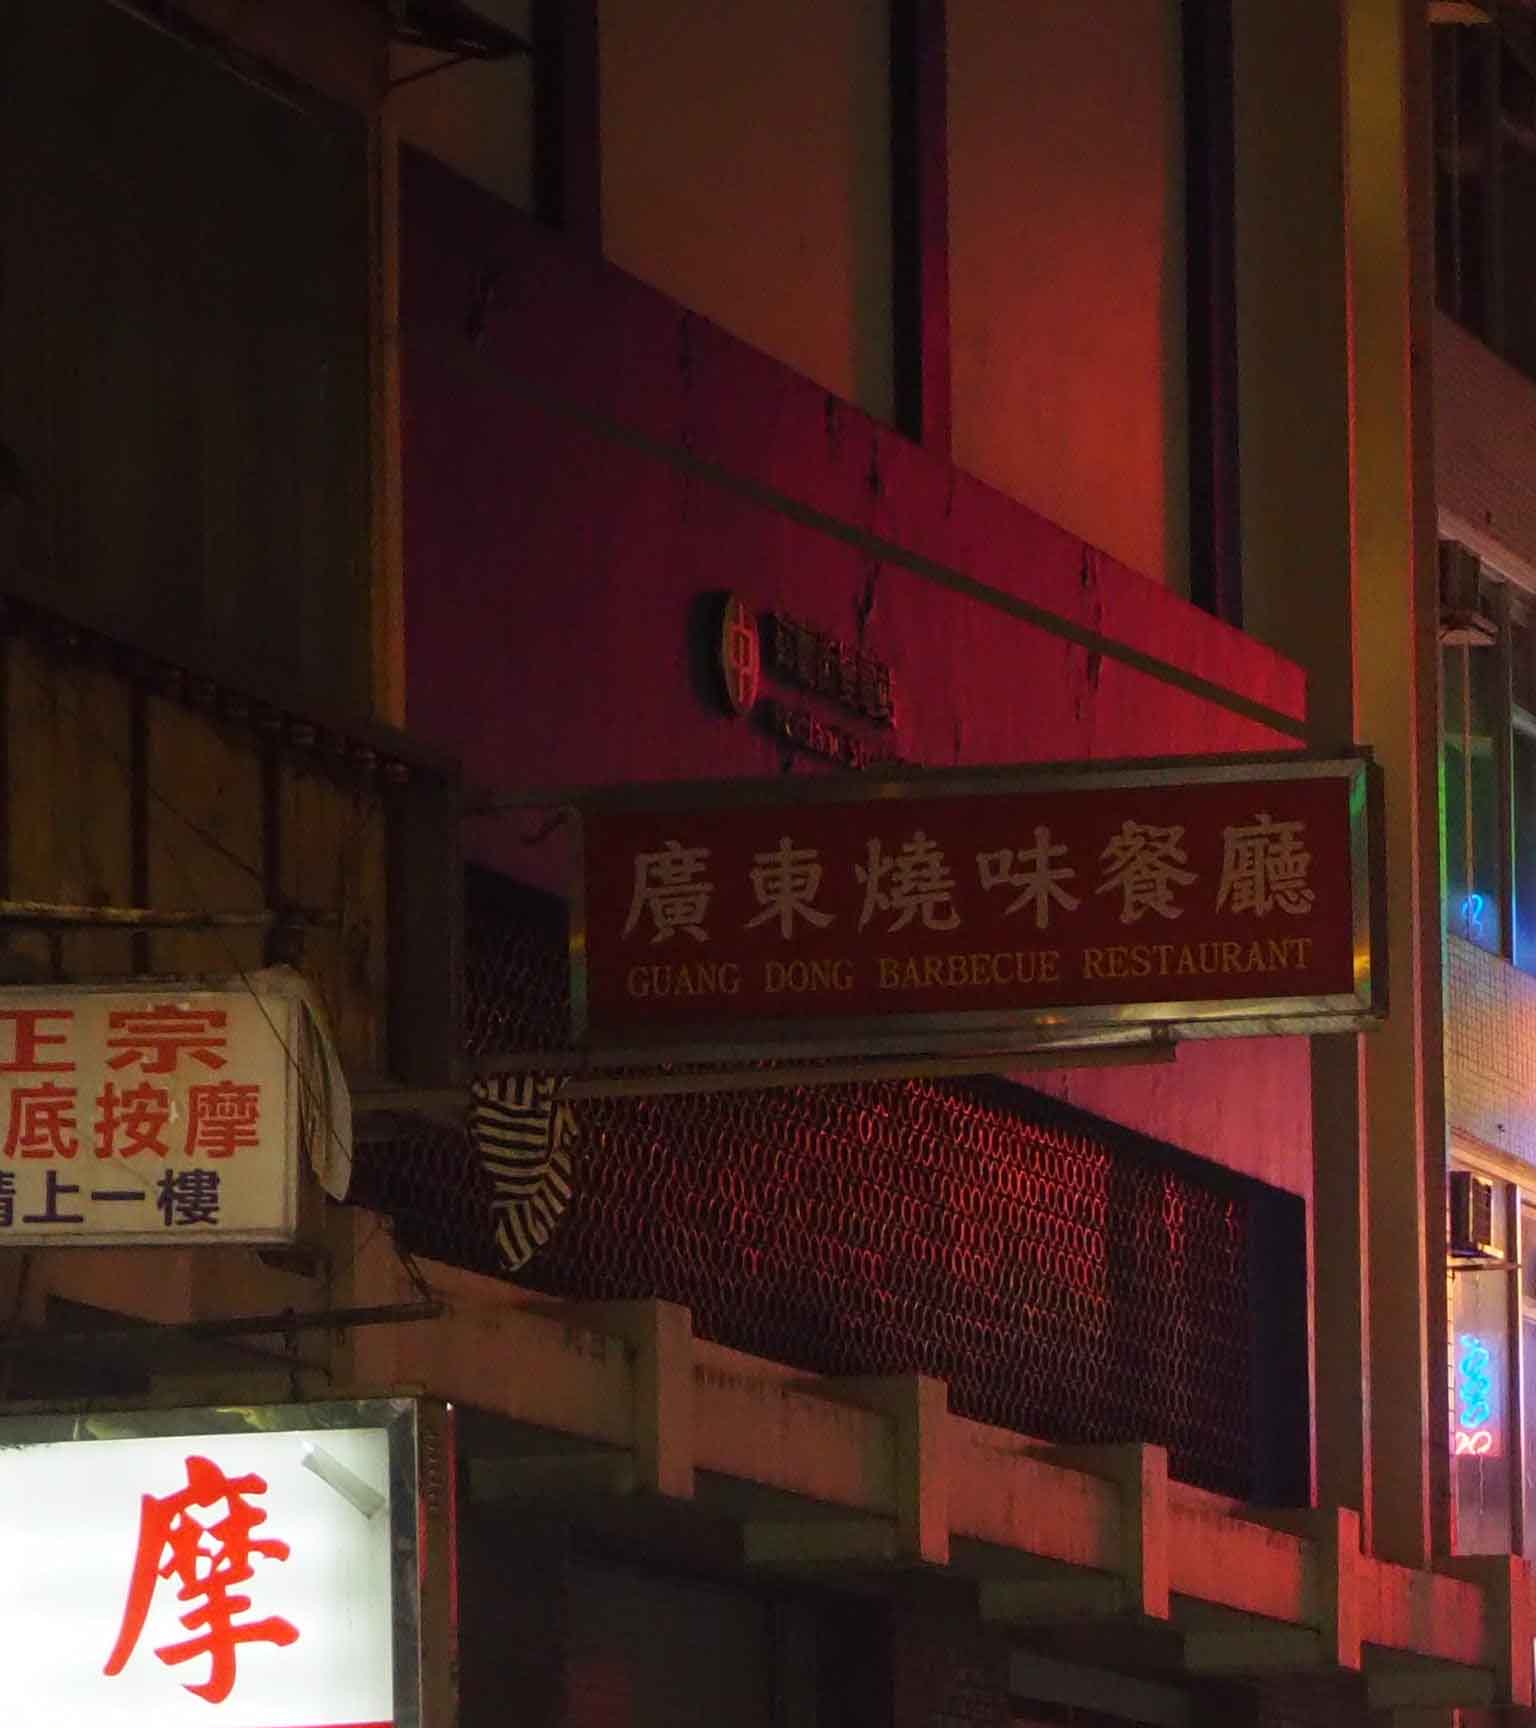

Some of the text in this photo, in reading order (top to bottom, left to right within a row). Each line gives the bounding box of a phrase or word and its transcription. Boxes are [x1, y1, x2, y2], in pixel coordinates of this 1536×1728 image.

[622, 813, 1316, 943] 廣東燒味餐廳
[627, 936, 1312, 997] GUANG DONG BARBECUE RESTAURANT
[0, 1168, 221, 1228] 上一樓
[104, 1455, 300, 1704] 摩
